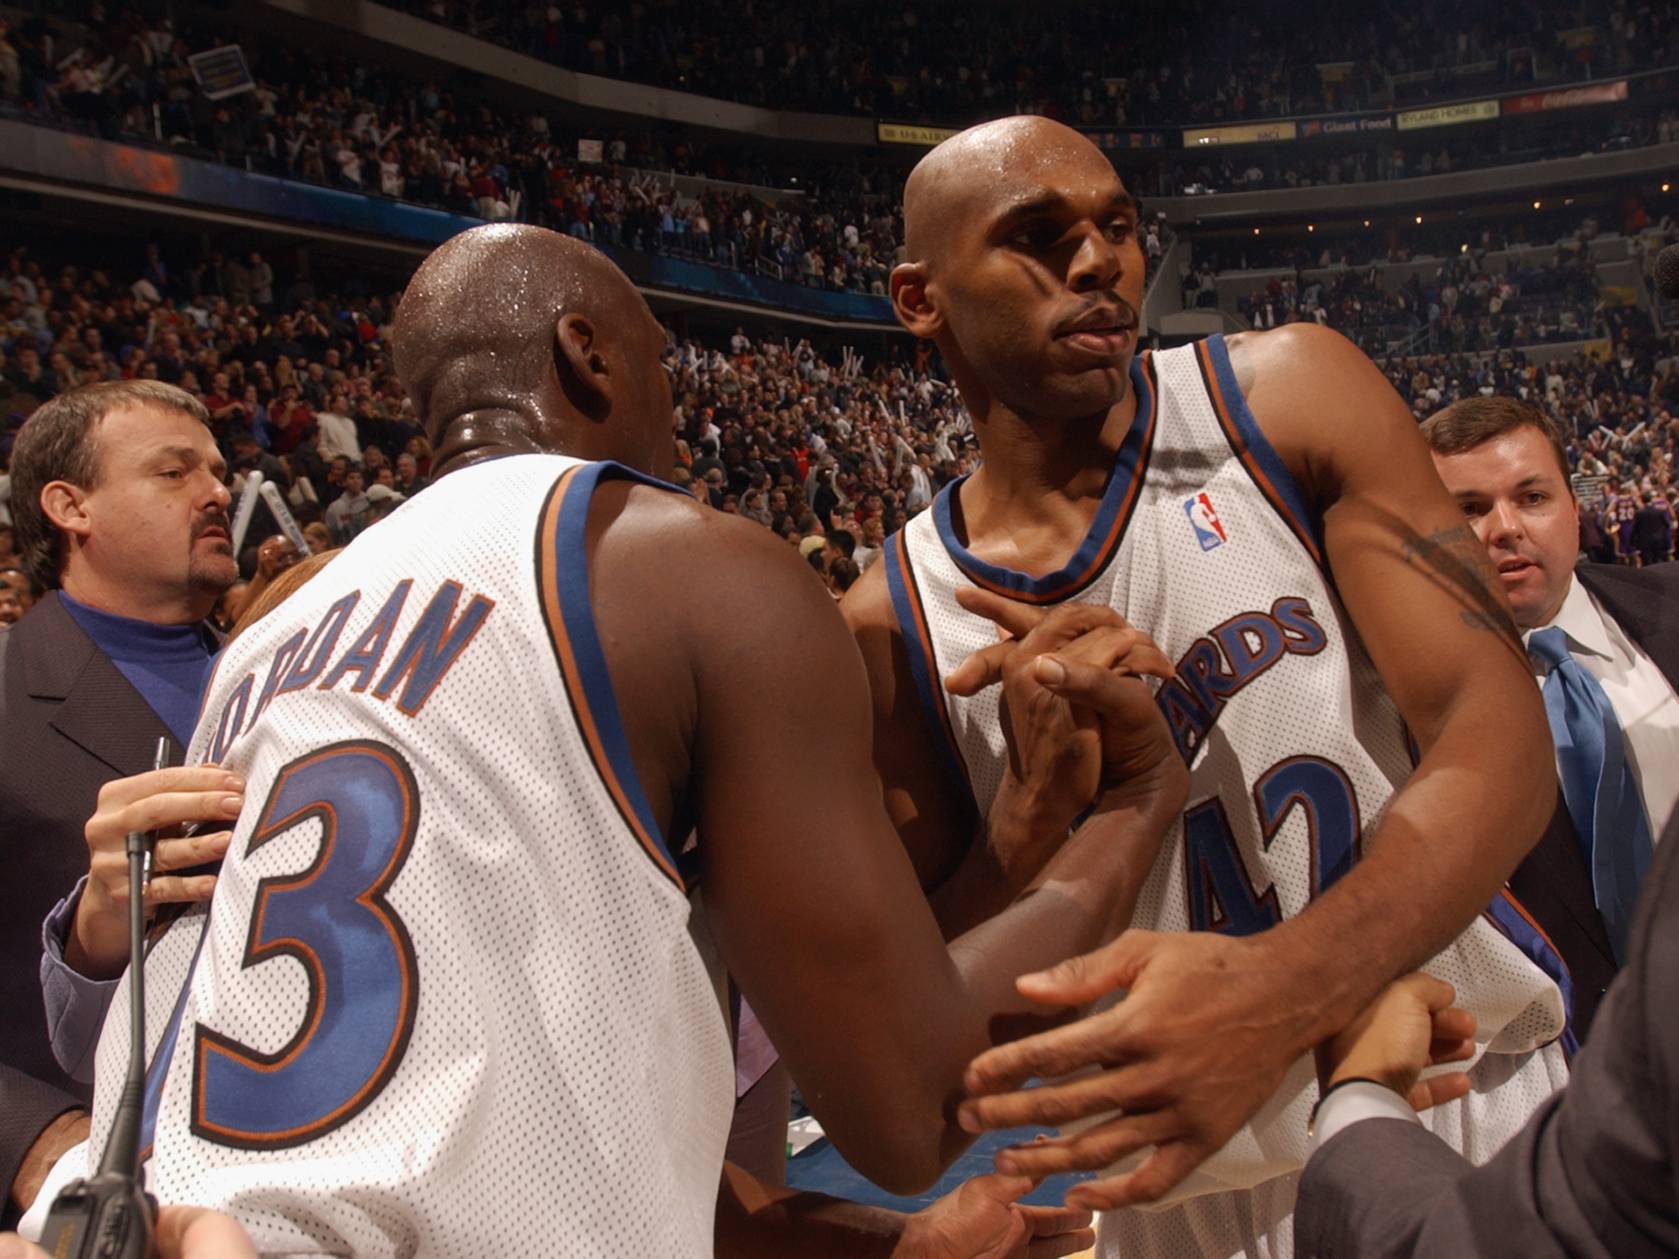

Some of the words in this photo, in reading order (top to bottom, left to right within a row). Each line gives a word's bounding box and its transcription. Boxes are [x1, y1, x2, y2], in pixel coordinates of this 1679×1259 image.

[1322, 119, 1357, 133] Giant
[1360, 116, 1392, 130] Food
[1618, 507, 1635, 522] 20
[1184, 753, 1363, 936] 42
[190, 738, 421, 1151] 3
